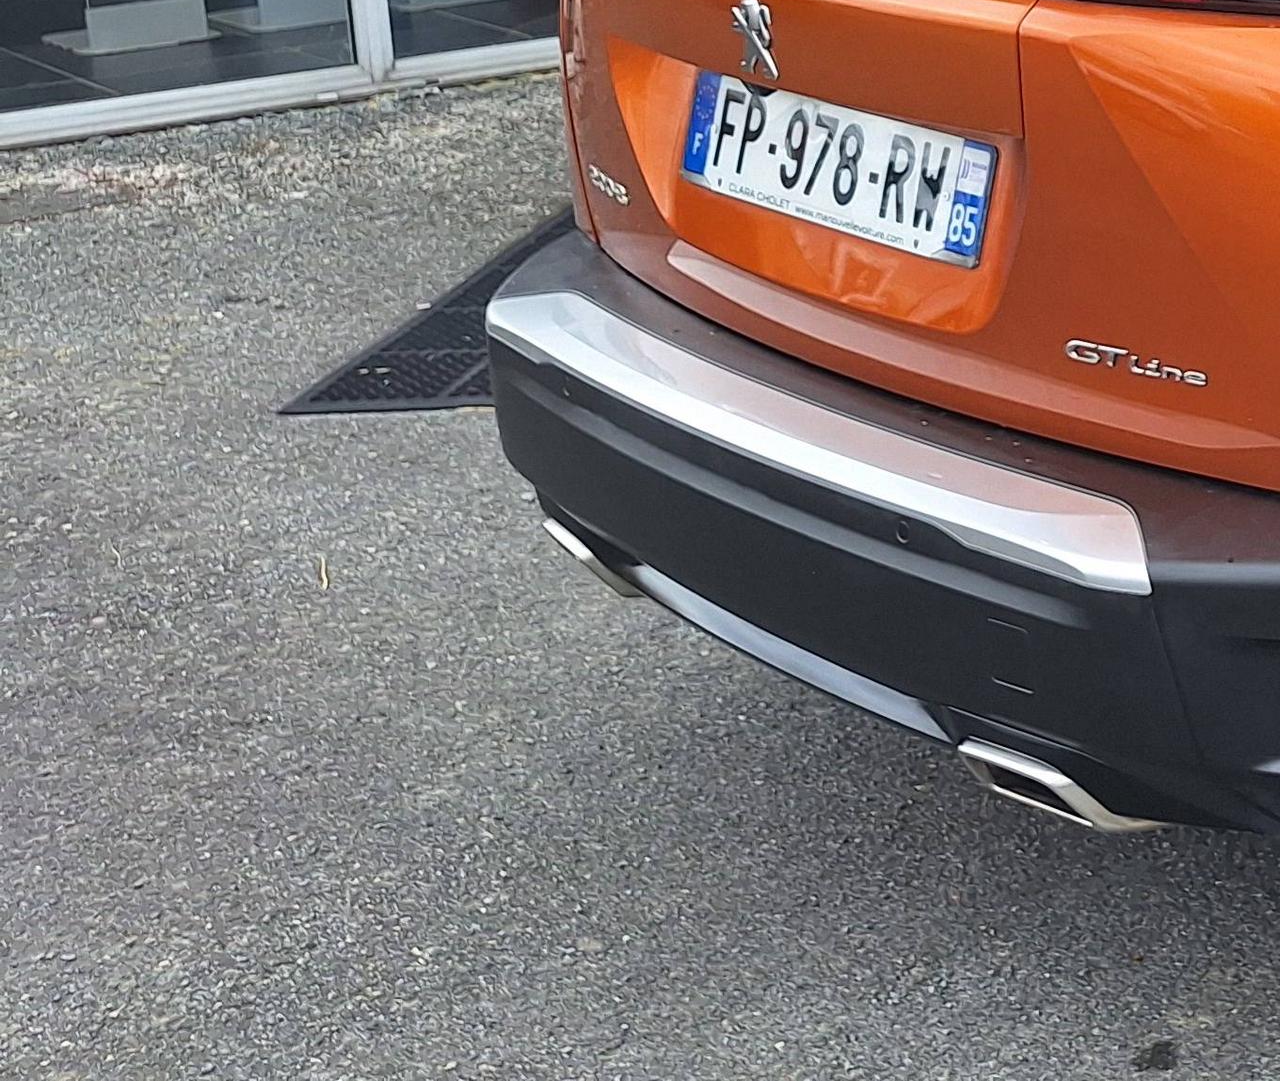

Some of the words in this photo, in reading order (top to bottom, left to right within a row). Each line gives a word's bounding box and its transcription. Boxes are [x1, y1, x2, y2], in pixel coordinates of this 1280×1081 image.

[691, 132, 704, 155] F
[713, 87, 951, 232] FP-978-RW
[728, 182, 756, 200] CLARA
[756, 192, 791, 211] CHOLET
[949, 202, 980, 247] 85
[1065, 338, 1129, 368] GT
[1130, 354, 1208, 386] Line
